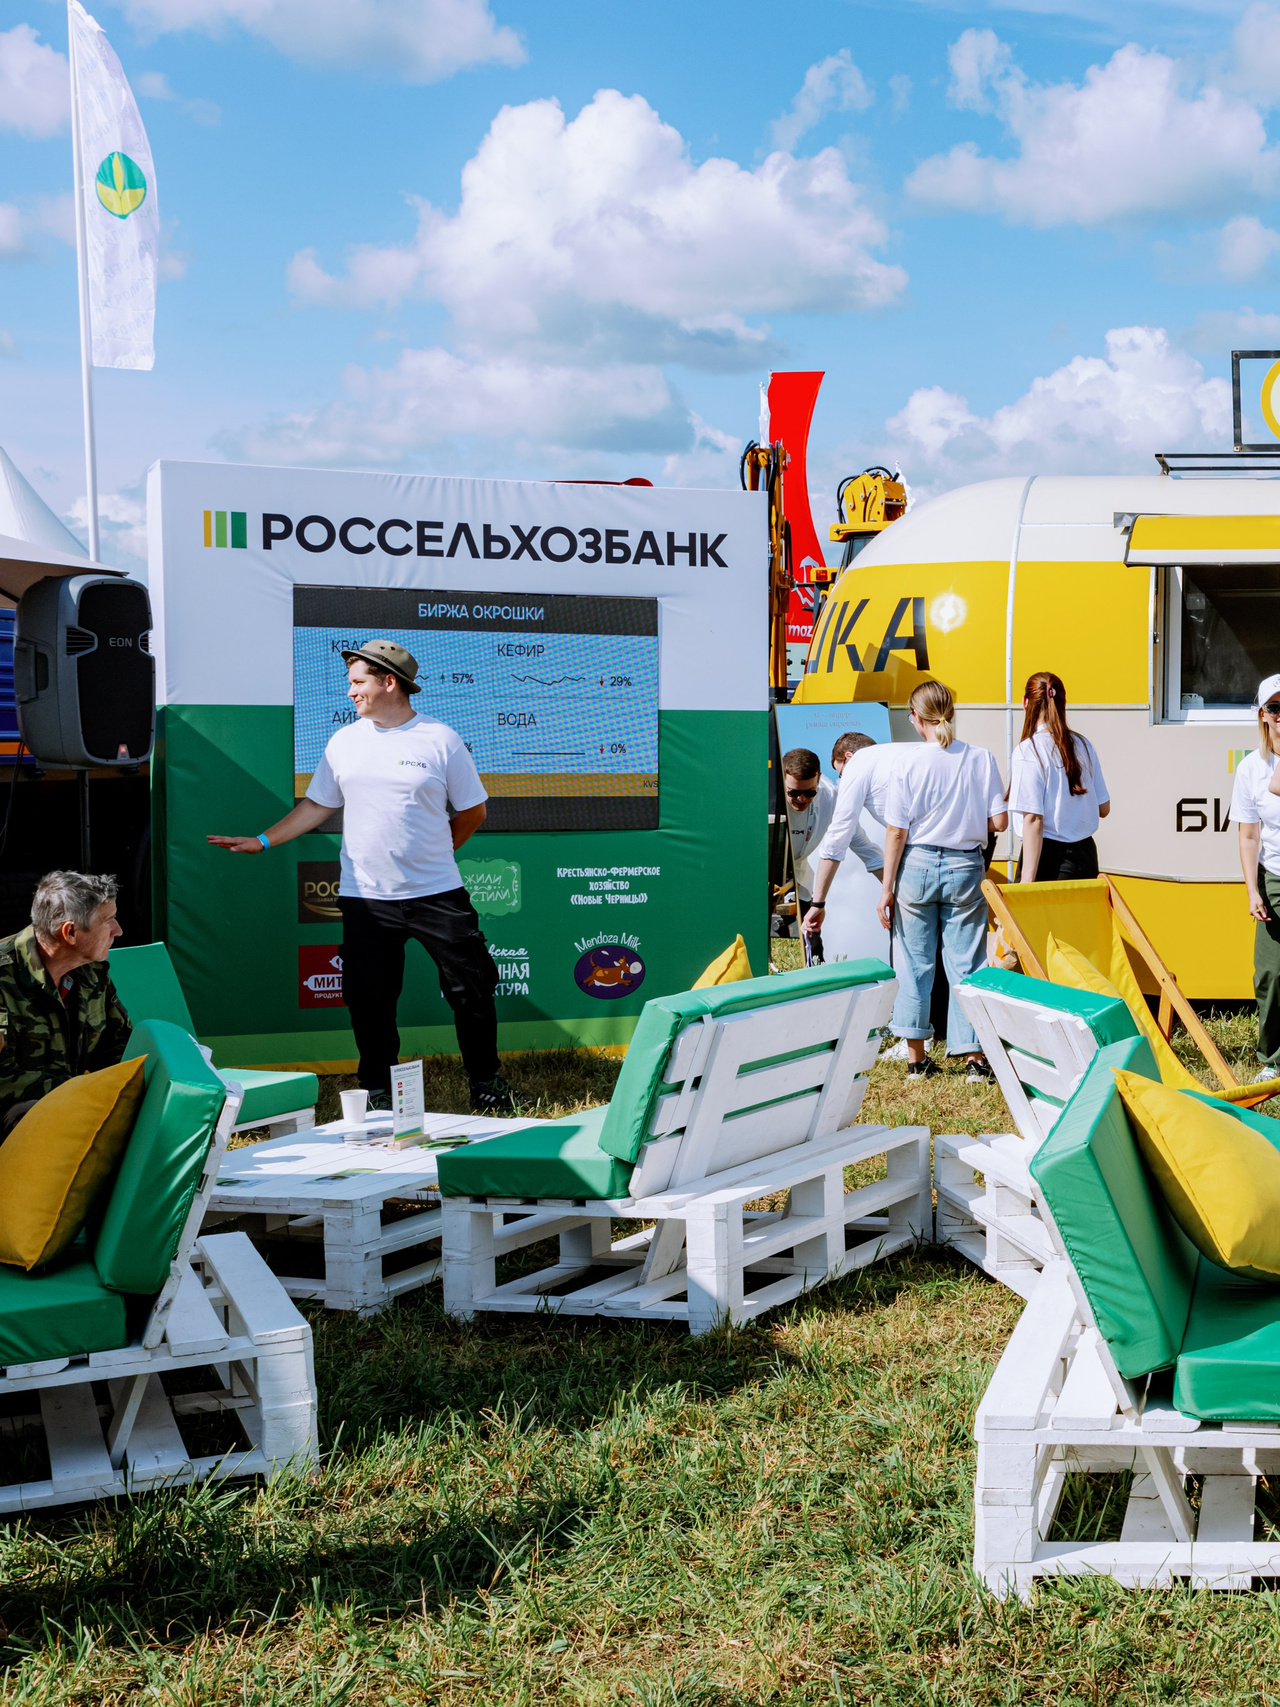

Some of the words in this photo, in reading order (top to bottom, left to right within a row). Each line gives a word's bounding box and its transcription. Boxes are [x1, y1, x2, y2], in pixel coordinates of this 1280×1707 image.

[262, 513, 728, 568] РОССЕЛЬХОЗБАНК
[418, 603, 470, 619] БИРЖА
[473, 605, 545, 621] ОКРОШКИ
[109, 637, 133, 648] EON
[497, 643, 545, 657] КЕФИР
[452, 674, 475, 686] 57%
[610, 677, 632, 688] 29%
[498, 713, 537, 728] ВОДА
[610, 744, 626, 755] 0%
[556, 866, 660, 878] КРЕСТЬЯНСКО-ФЕРМЕРСКОЕ
[589, 878, 630, 891] ХОЗЯЙСТВО
[574, 931, 618, 953] Mendoza
[620, 932, 641, 951] Milk
